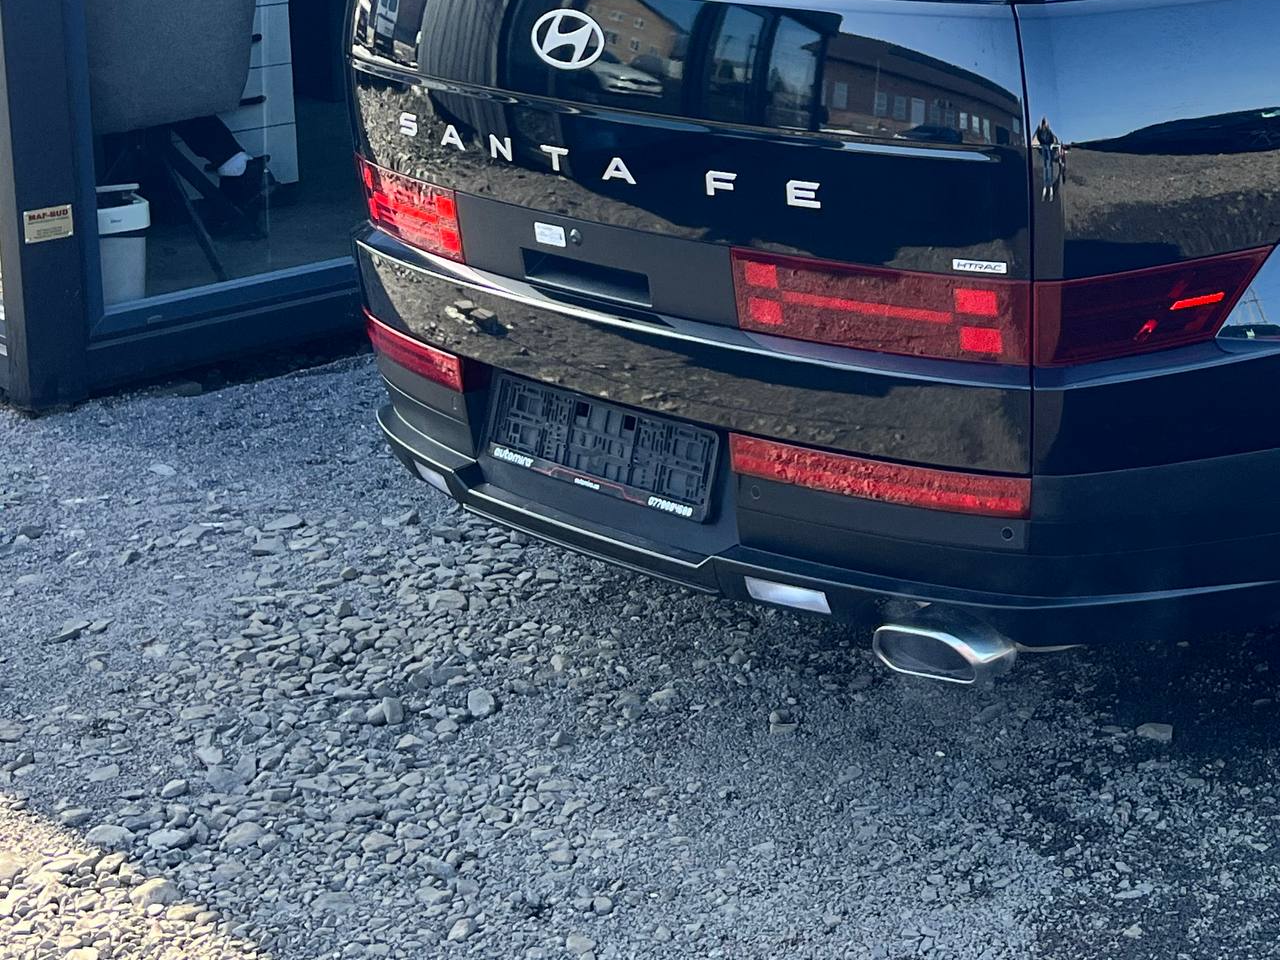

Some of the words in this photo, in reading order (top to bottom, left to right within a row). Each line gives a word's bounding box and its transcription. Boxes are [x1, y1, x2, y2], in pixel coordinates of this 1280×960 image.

[400, 112, 637, 185] SANTA
[706, 170, 821, 209] FE
[956, 261, 1003, 272] HTRAC
